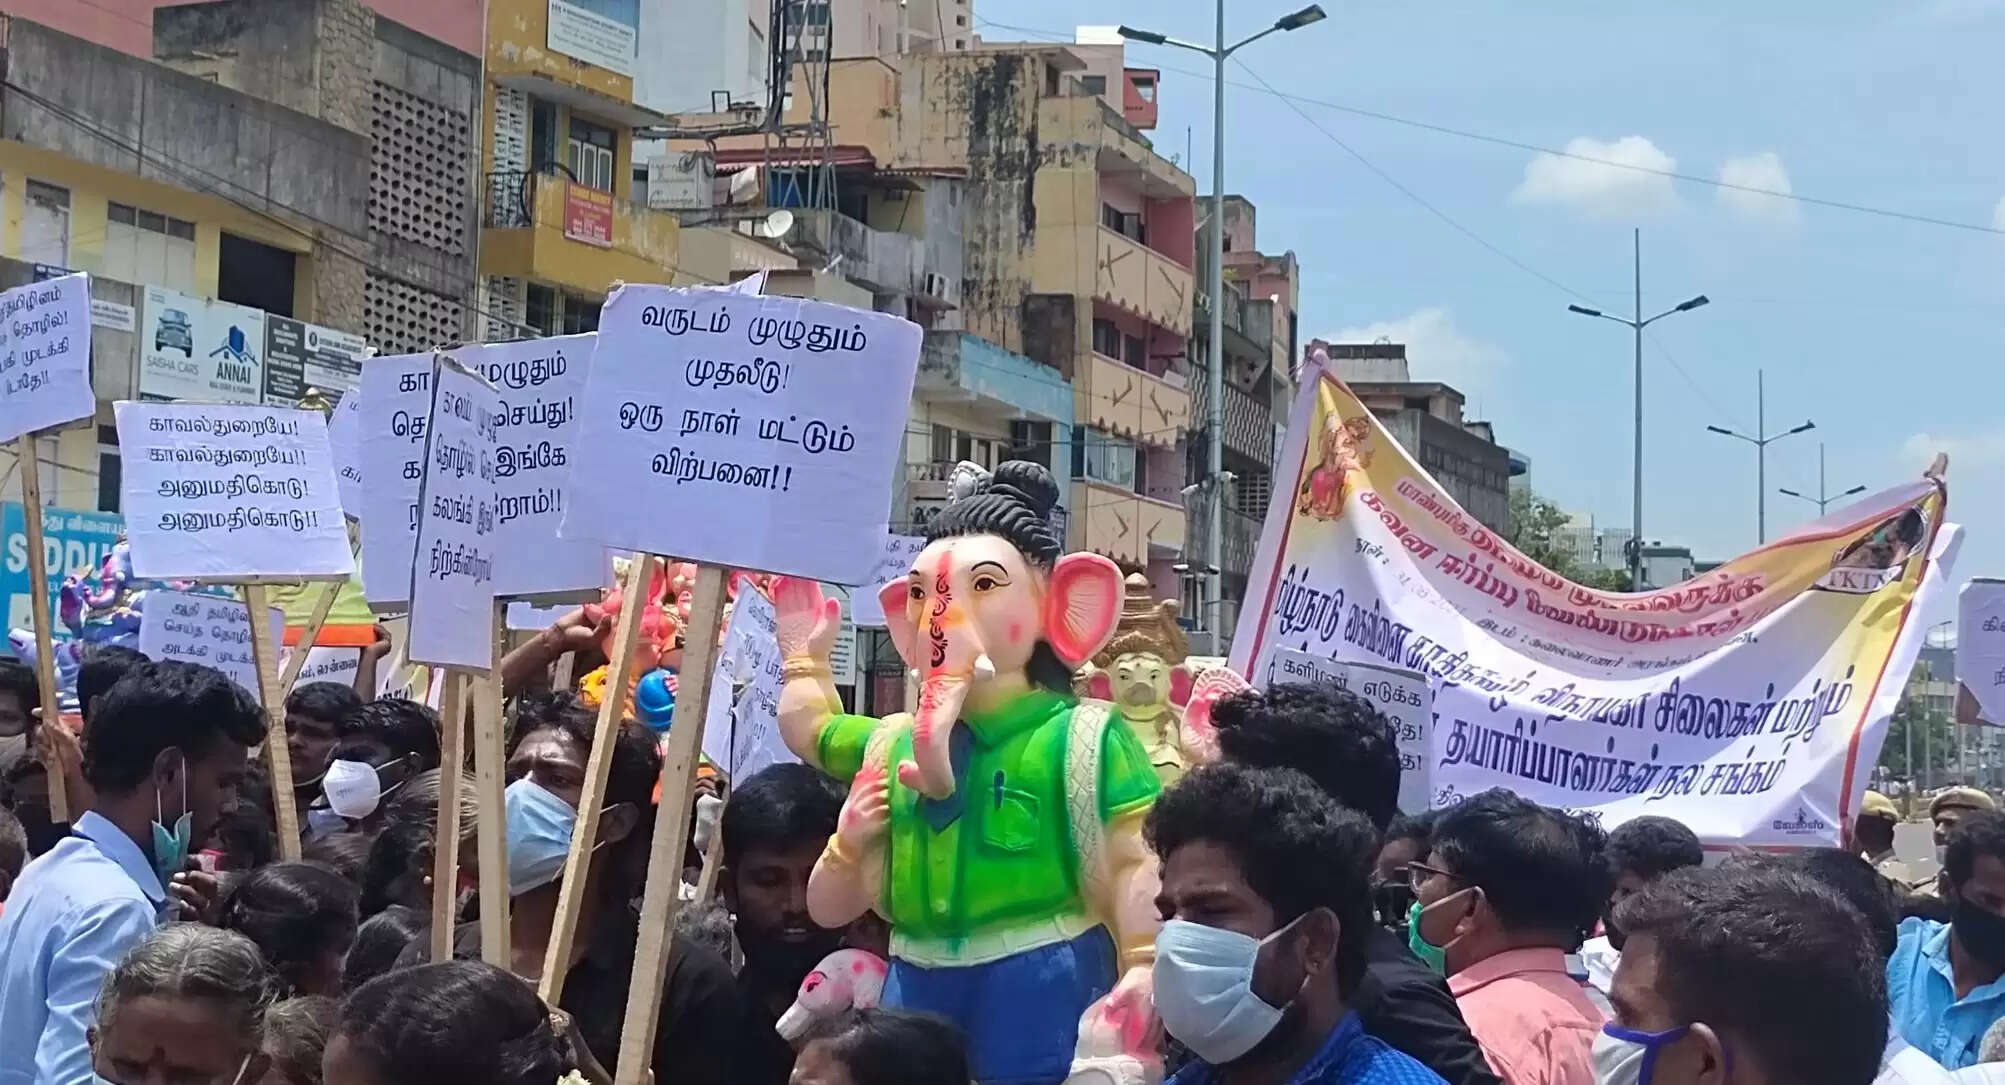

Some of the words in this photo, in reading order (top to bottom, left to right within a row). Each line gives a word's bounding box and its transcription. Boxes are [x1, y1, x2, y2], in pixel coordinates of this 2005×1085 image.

[641, 305, 731, 336] வருடம்
[748, 315, 867, 353] முழுதும்
[216, 361, 252, 385] ANNAI
[685, 356, 791, 394] முதலீடு!
[149, 416, 299, 438] காவல்துறையே!
[618, 401, 663, 432] ஒரு
[681, 407, 741, 438] நாள்
[758, 415, 855, 455] மட்டும்
[149, 445, 307, 468] காவல்துறையே!!
[495, 440, 566, 477] இங்கே
[651, 446, 793, 492] விற்பனை!!
[158, 475, 309, 500] அனுமதிகொடு!
[158, 507, 318, 533] அனுமதிகொடு!!
[6, 532, 110, 577] SDDU
[1654, 676, 1780, 739] சிலைகள்
